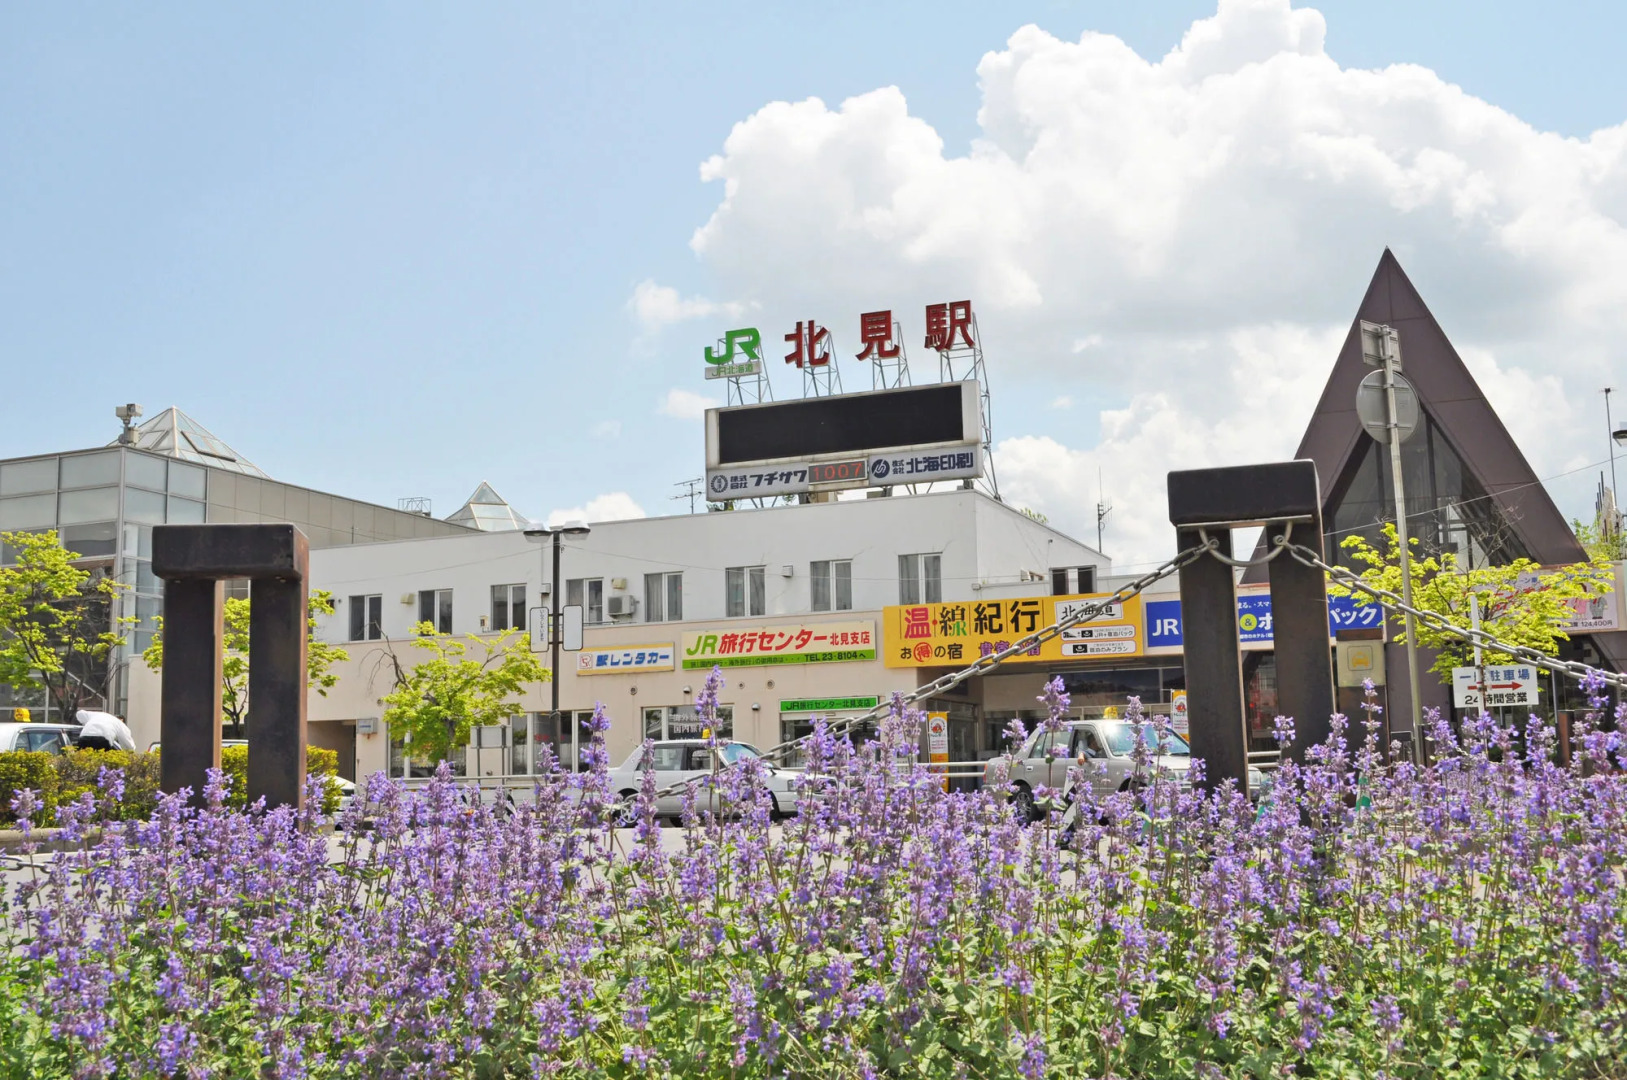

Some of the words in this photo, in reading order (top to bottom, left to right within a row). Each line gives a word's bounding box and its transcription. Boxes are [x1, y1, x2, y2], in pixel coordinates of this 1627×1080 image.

[704, 327, 760, 365] JR
[784, 300, 975, 368] 北見駅
[813, 462, 863, 480] 1007
[906, 452, 974, 474] 北海印刷
[1152, 618, 1180, 637] JR
[596, 652, 669, 667] 駅レンタカー
[804, 653, 820, 662] TEL
